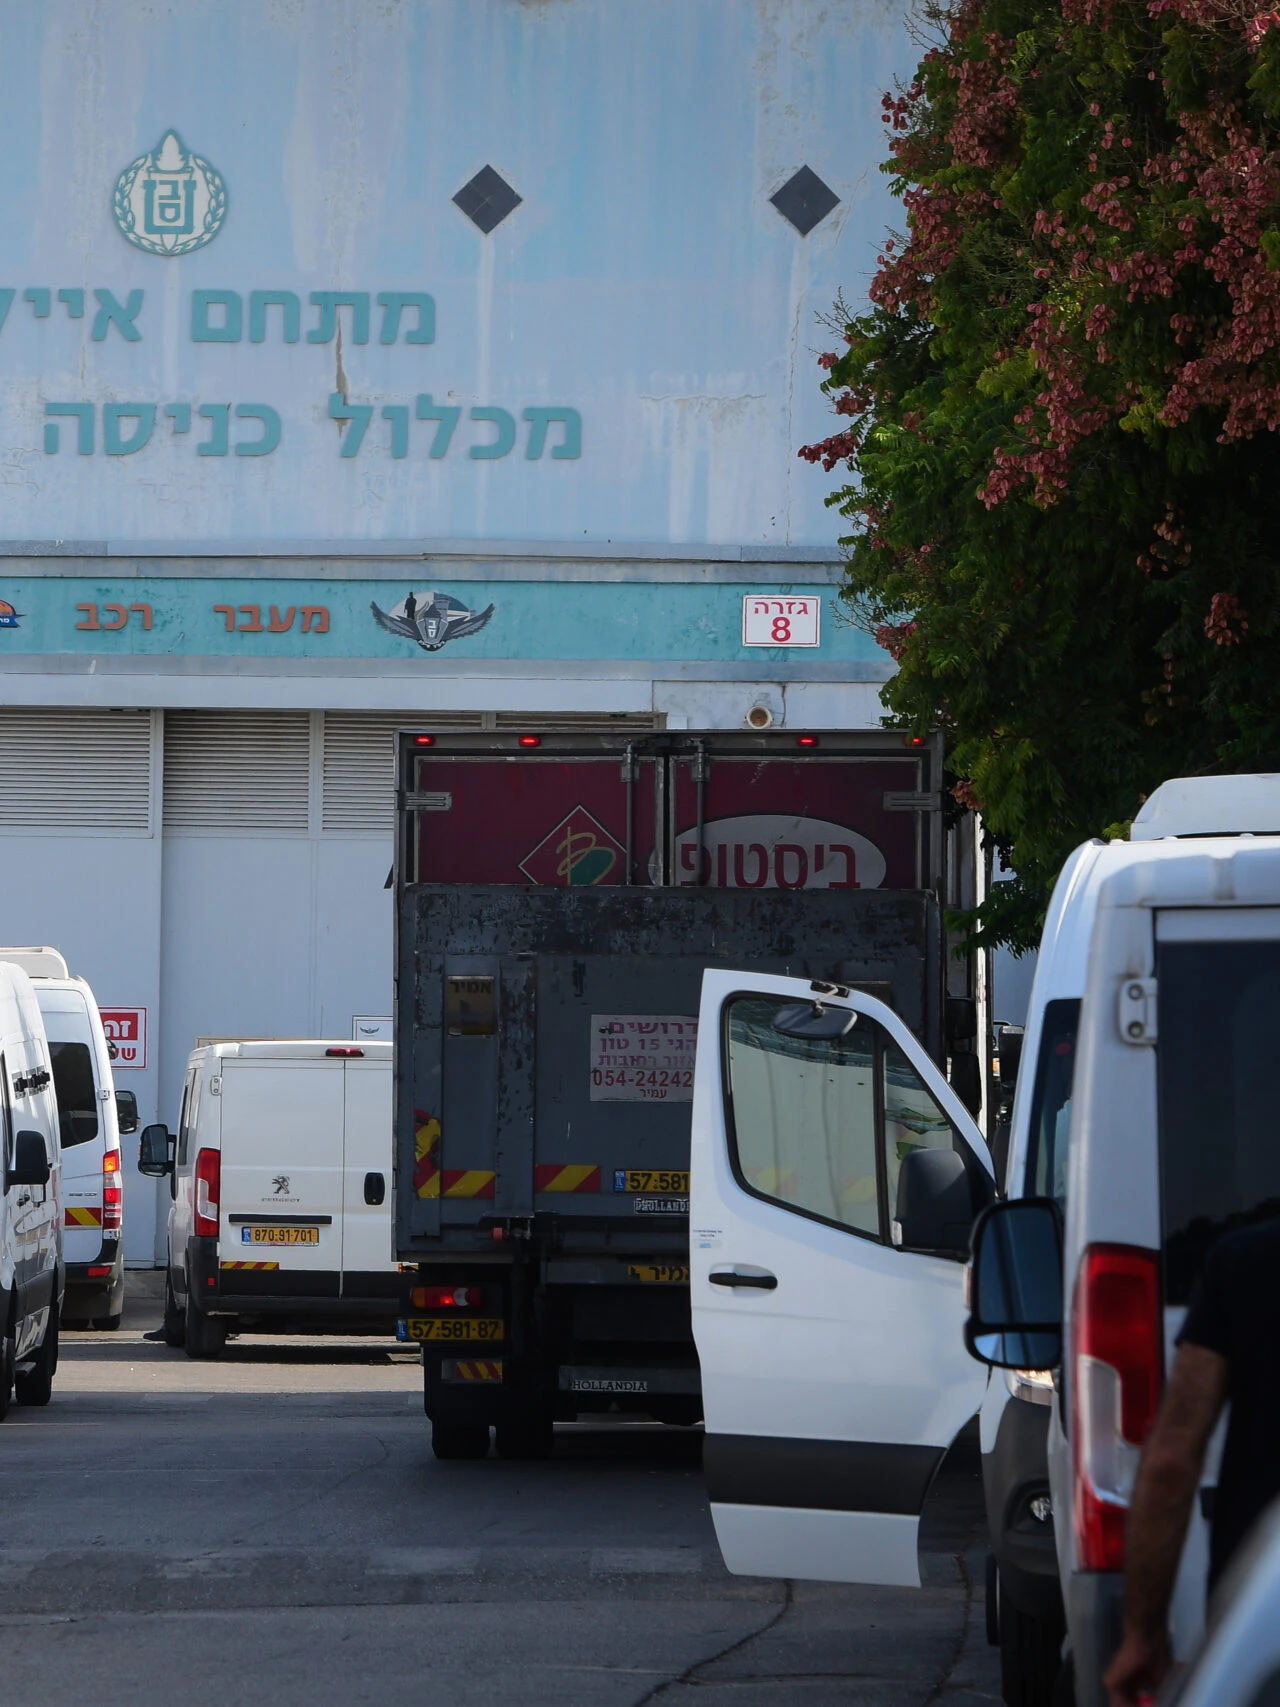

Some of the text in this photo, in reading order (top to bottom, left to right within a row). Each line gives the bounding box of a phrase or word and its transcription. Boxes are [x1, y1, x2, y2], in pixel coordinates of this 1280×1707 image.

[191, 289, 436, 345] מתחם
[44, 402, 281, 457] כניסה
[329, 392, 582, 460] מכלול
[75, 602, 330, 633] מעבר רכב
[754, 601, 809, 615] גזרה
[771, 616, 792, 643] 8
[680, 843, 862, 888] ביסטופ
[600, 1037, 630, 1053] טון
[638, 1038, 660, 1050] 15
[593, 1069, 693, 1088] 054-24242
